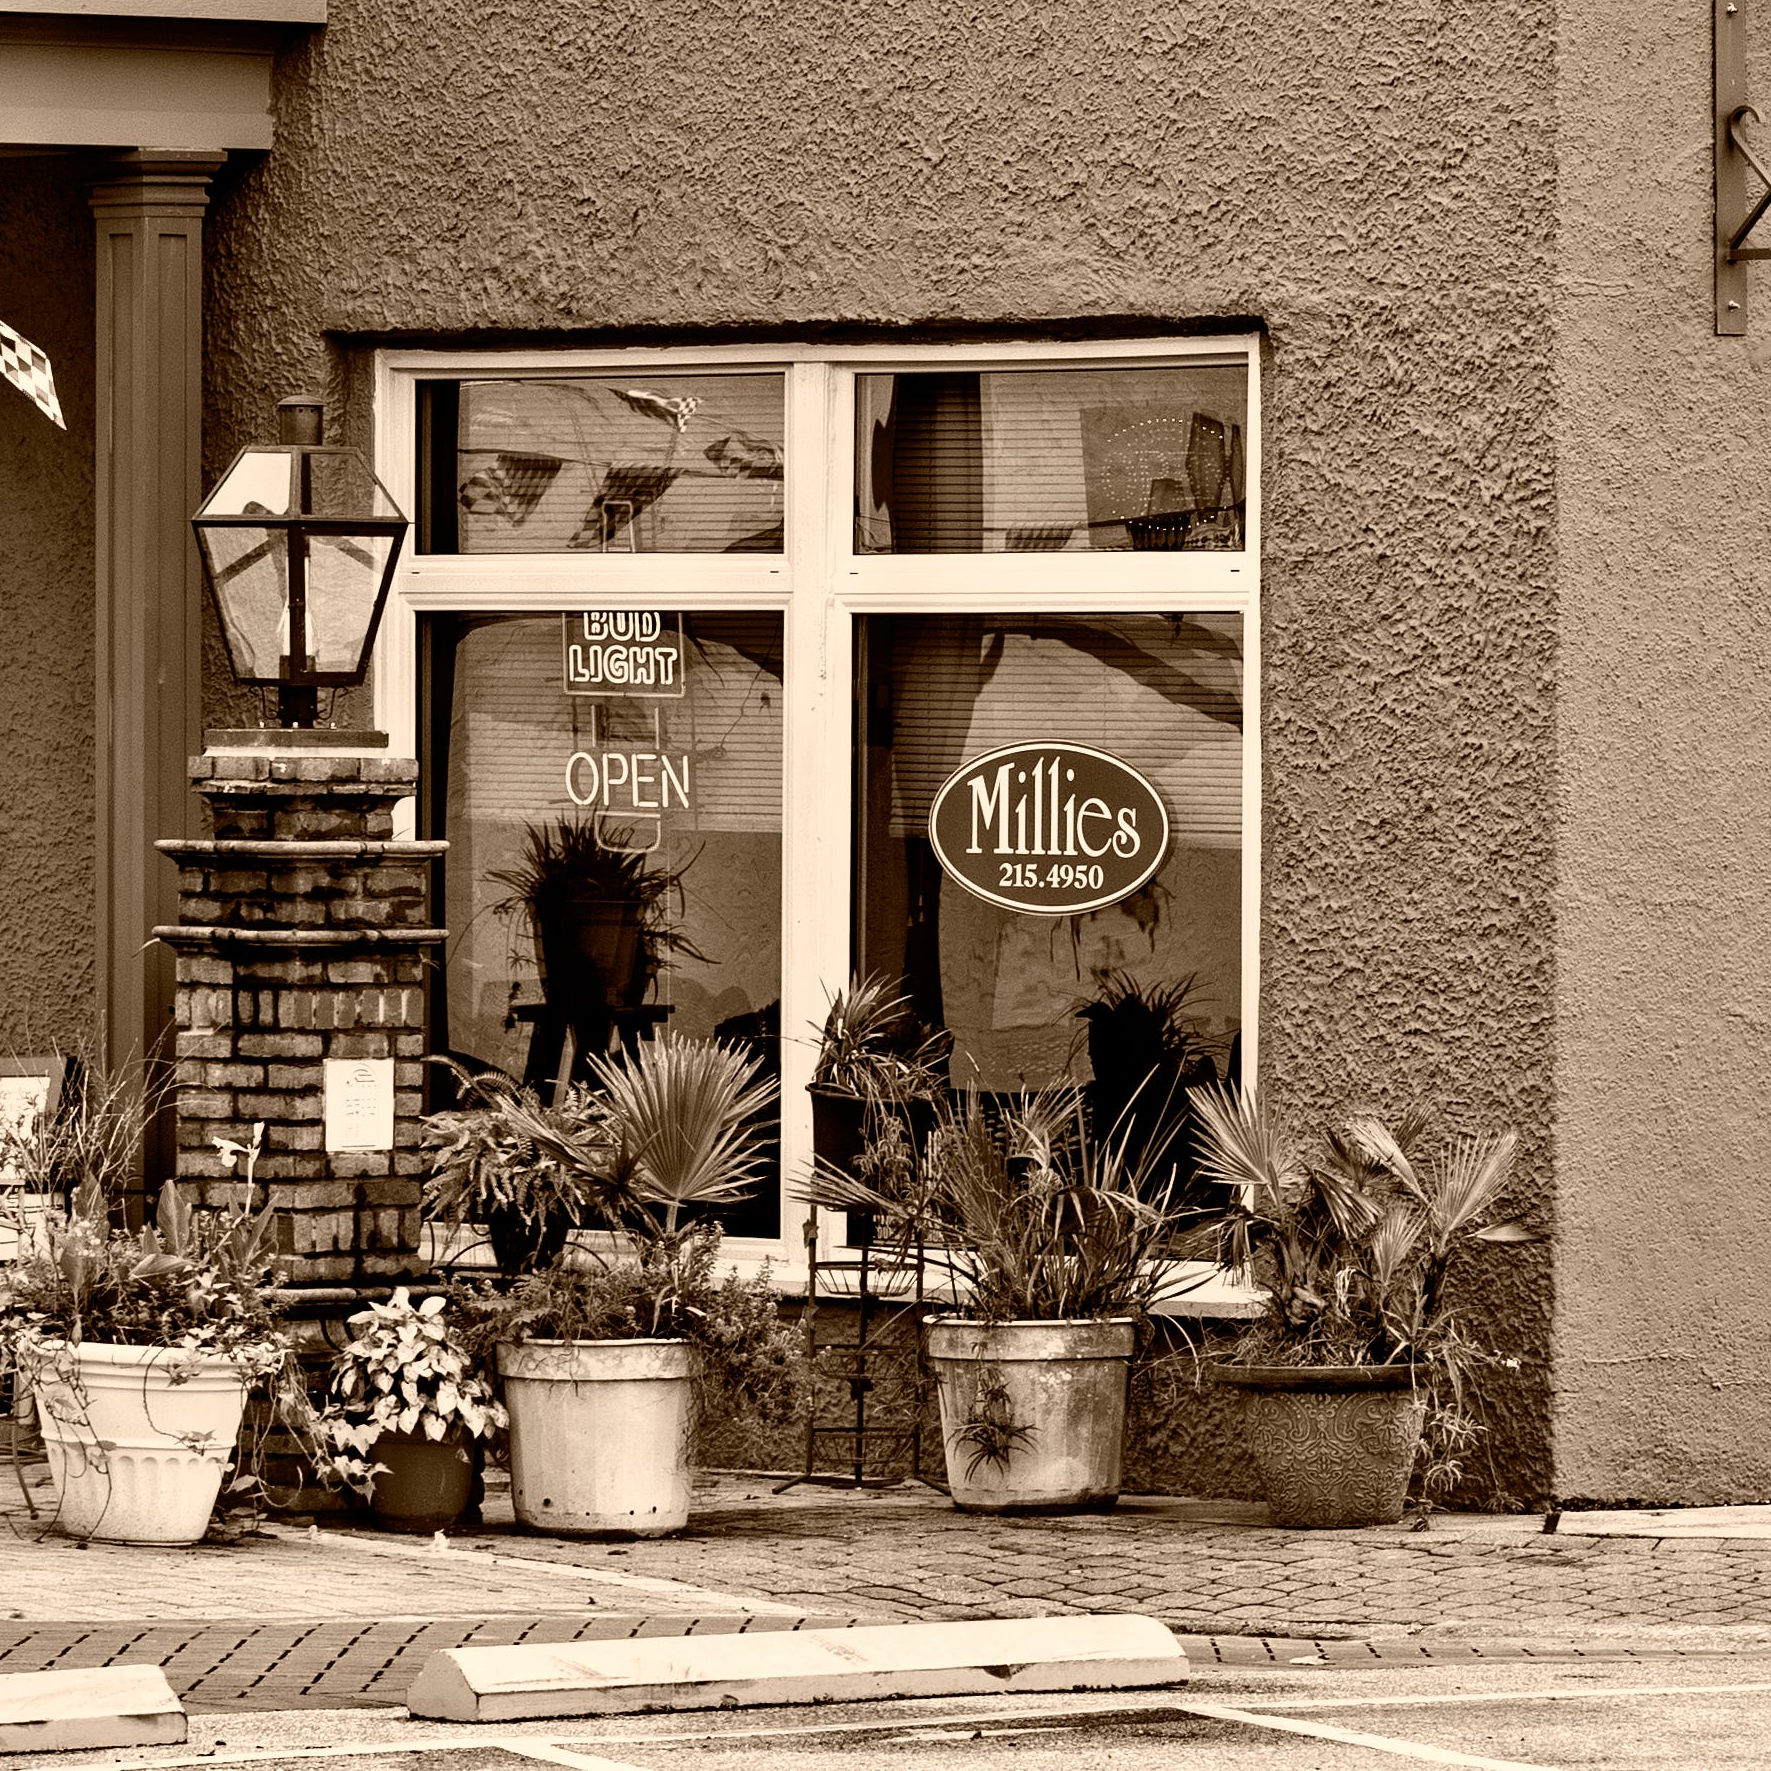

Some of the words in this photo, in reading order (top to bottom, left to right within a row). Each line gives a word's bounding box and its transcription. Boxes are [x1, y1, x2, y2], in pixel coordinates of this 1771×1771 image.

[583, 612, 661, 642] BUD
[568, 644, 678, 685] LIGHT
[565, 751, 690, 809] OPEN
[965, 755, 1142, 859] Millies
[998, 862, 1105, 890] 215.4950
